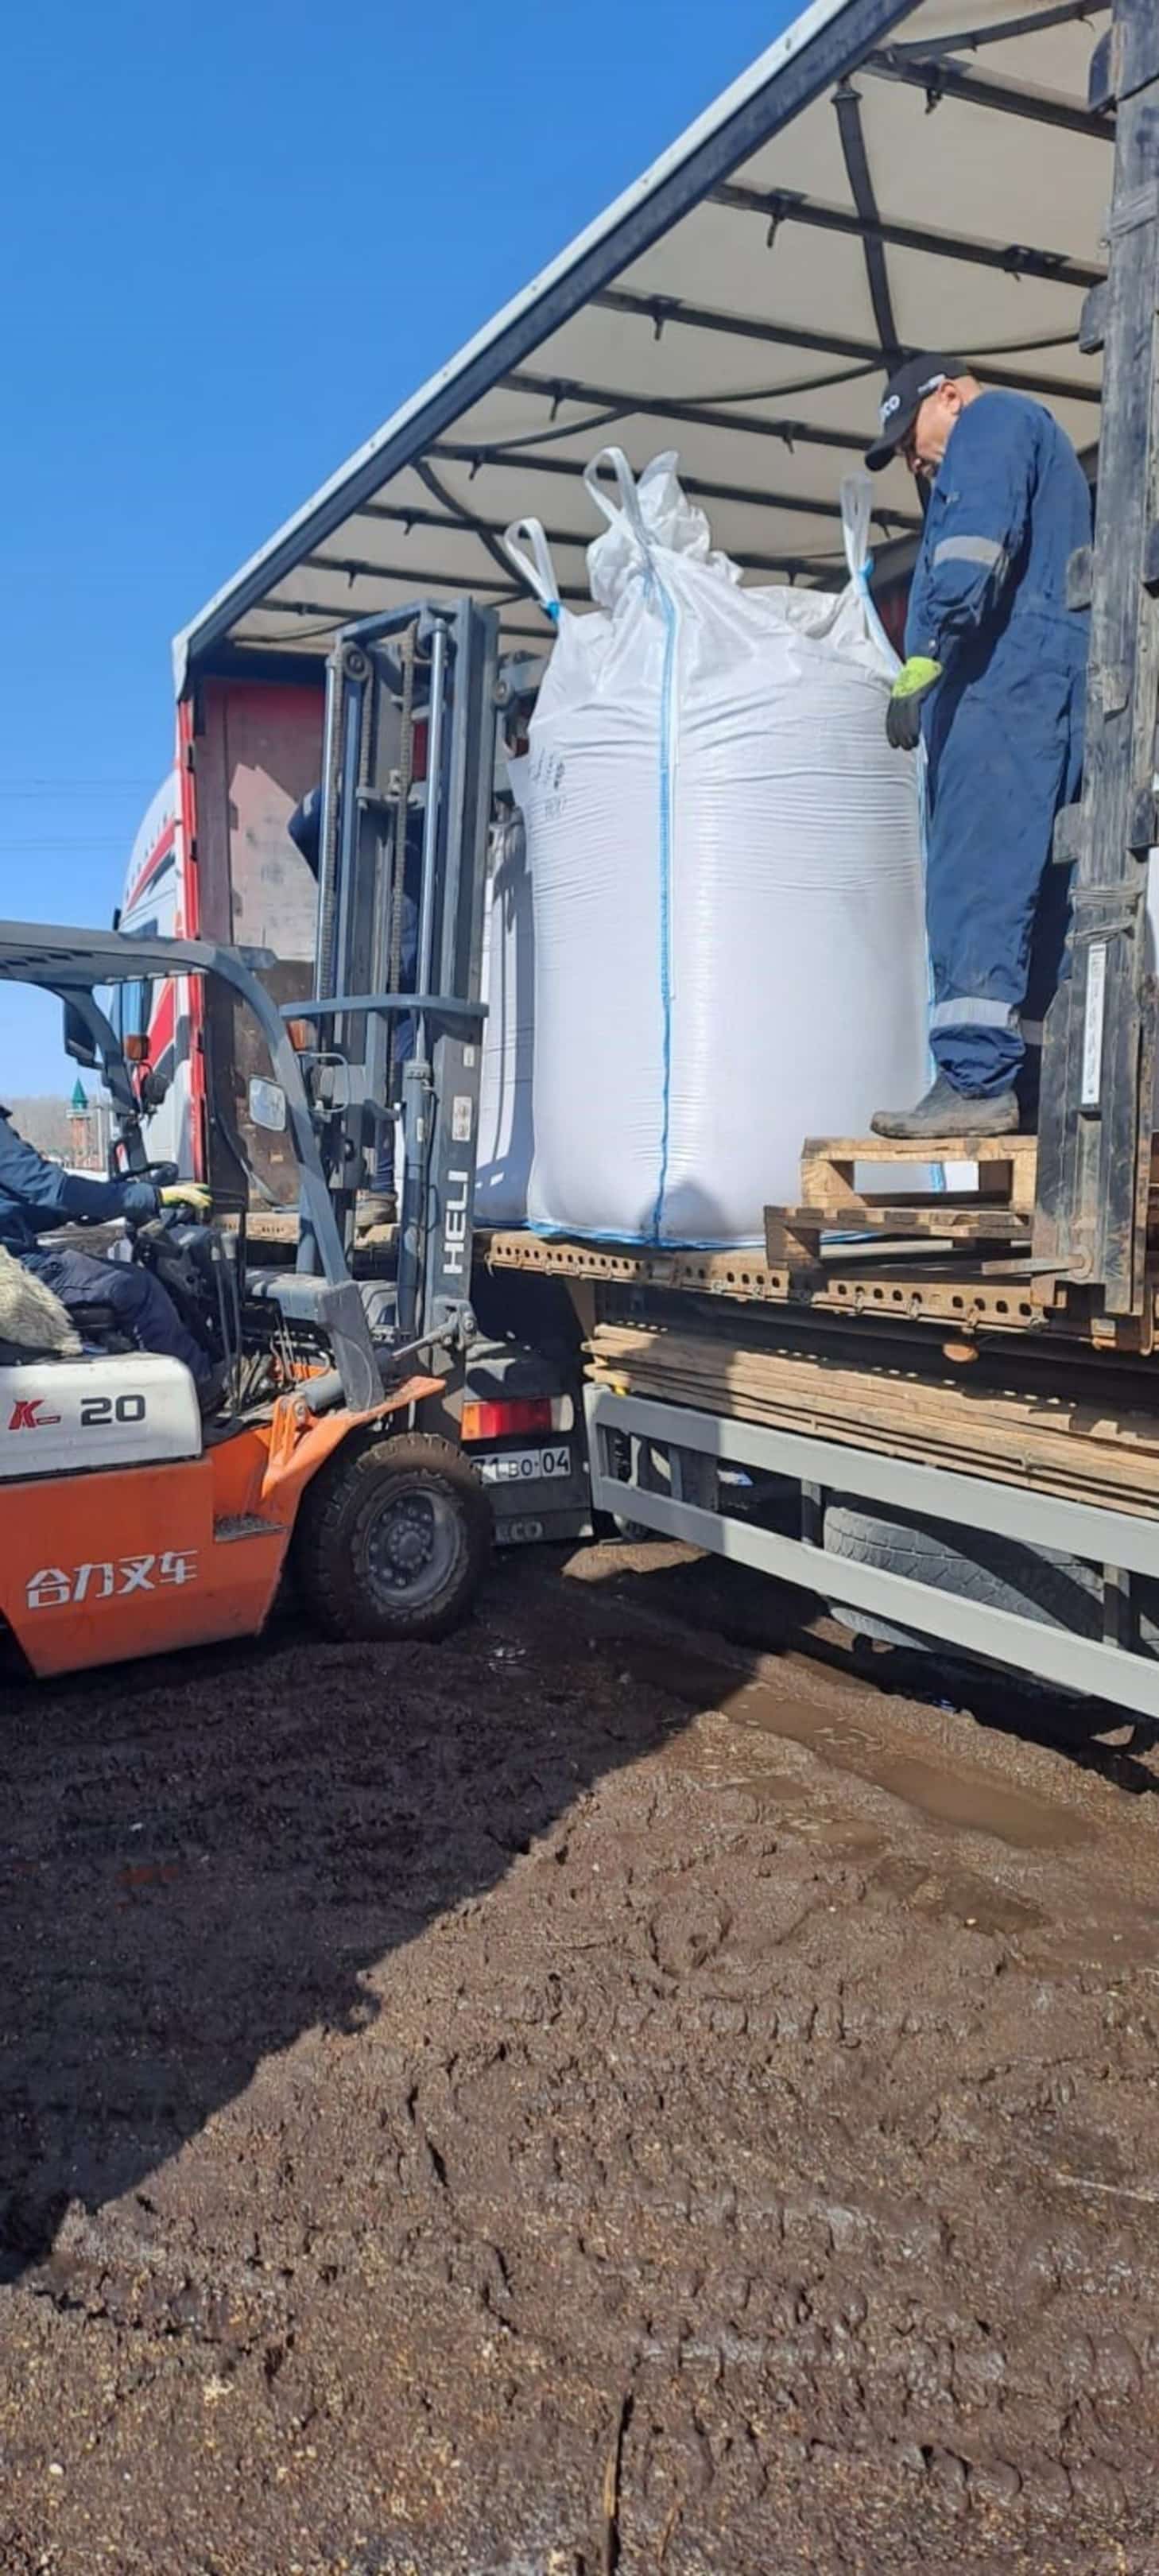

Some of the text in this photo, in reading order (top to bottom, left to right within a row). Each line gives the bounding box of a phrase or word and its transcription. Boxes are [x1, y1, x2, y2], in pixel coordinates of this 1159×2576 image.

[443, 1170, 469, 1274] HELI
[81, 1395, 145, 1427] 20
[25, 1550, 198, 1609] 合力叉车
